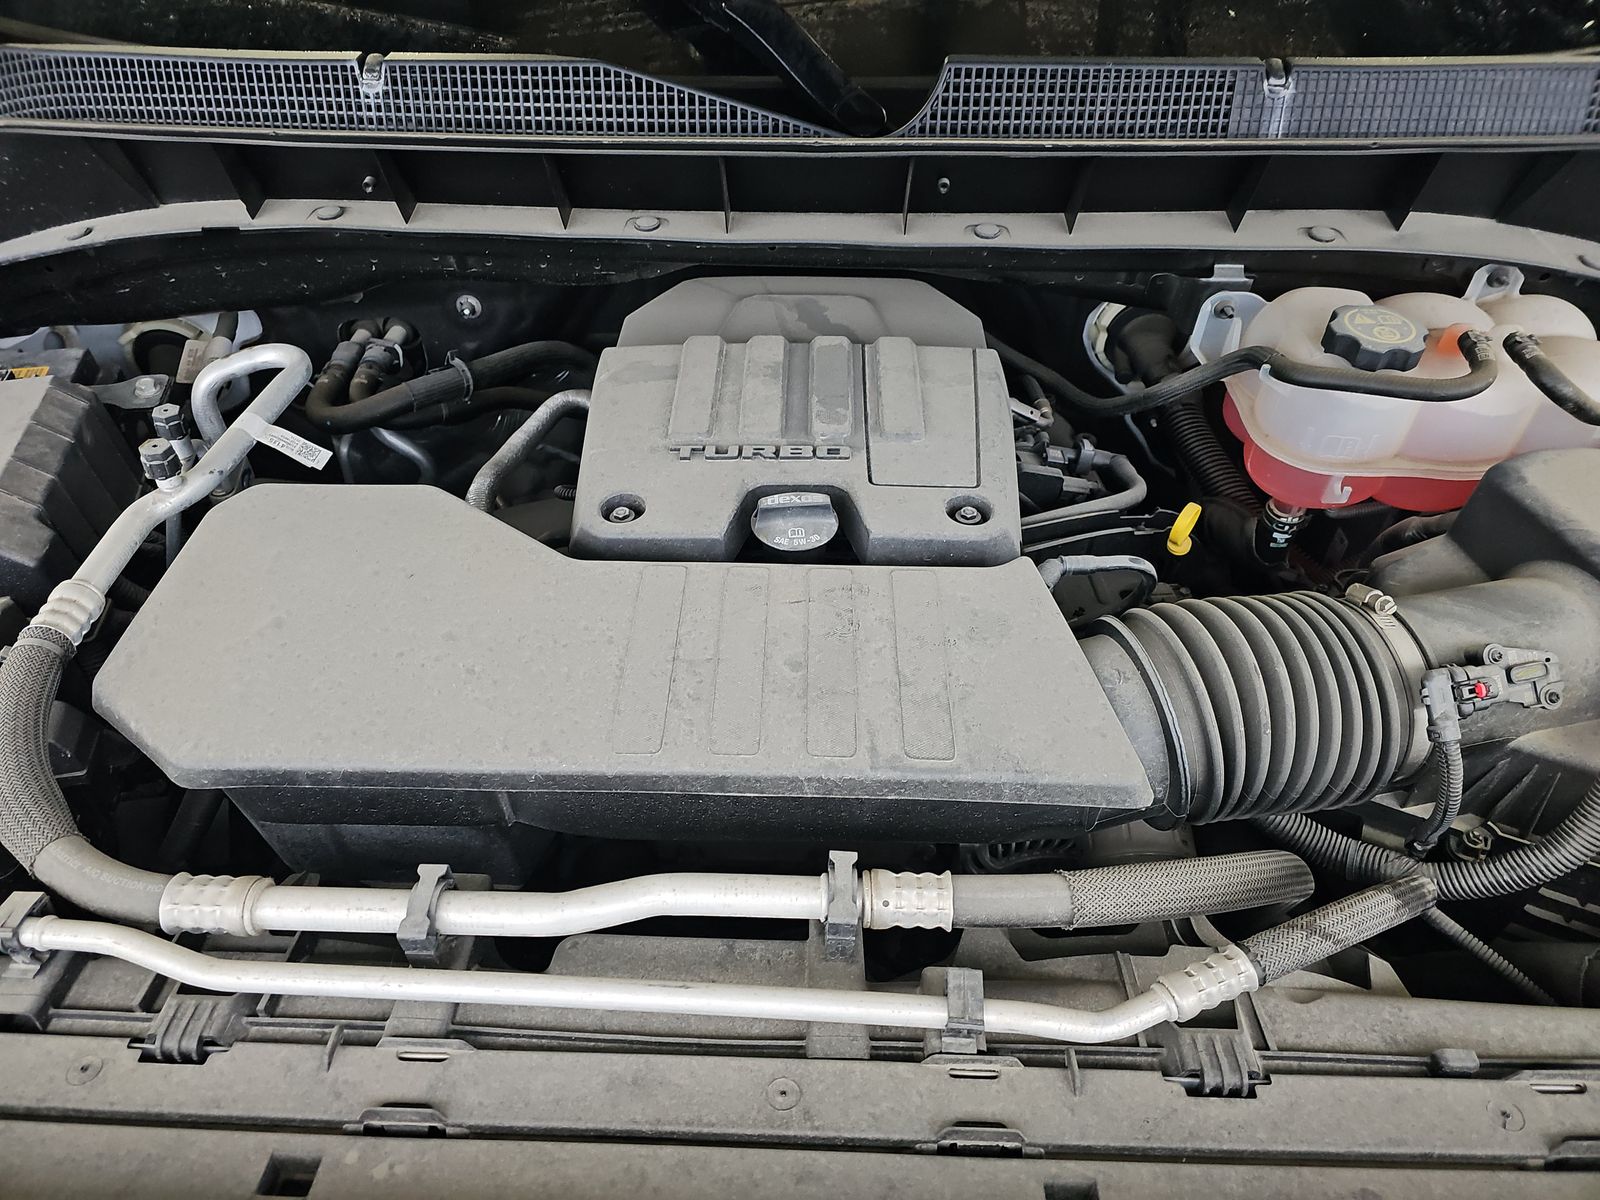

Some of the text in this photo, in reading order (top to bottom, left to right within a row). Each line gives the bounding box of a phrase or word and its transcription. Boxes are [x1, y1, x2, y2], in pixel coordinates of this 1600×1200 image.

[669, 445, 851, 461] TURBO
[767, 494, 824, 505] dexos
[773, 534, 821, 546] SAE 5W-30
